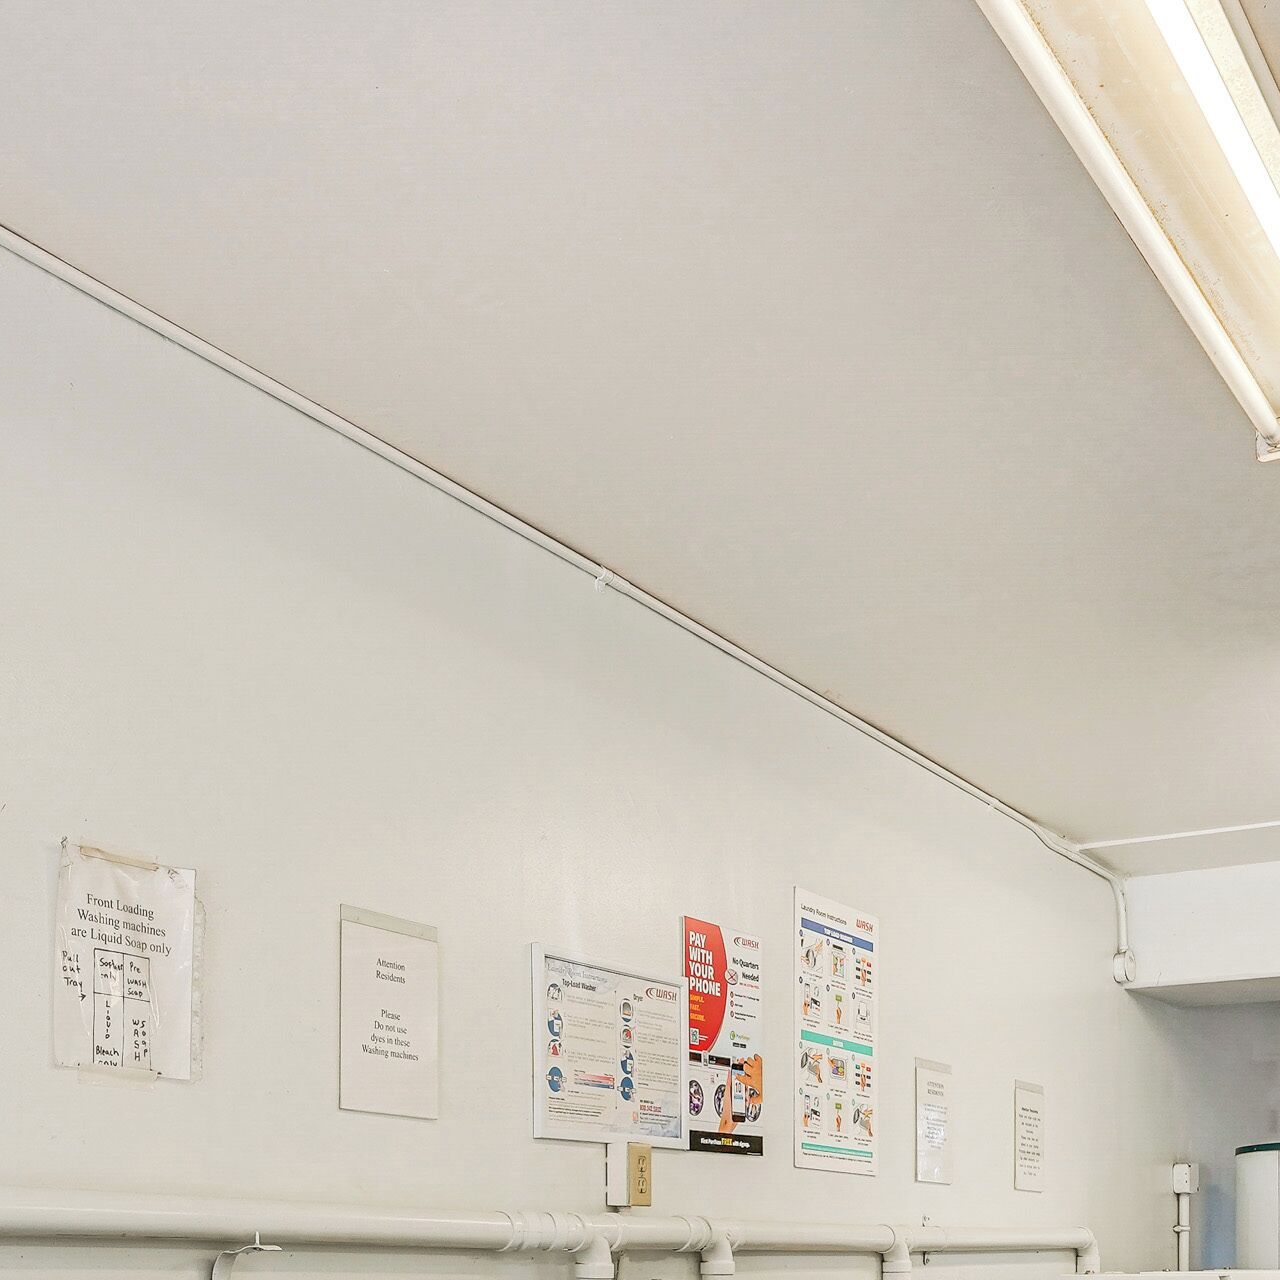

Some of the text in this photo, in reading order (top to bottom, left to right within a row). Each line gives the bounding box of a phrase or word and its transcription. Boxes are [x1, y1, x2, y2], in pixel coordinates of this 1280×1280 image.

[87, 893, 155, 921] Front Loading
[77, 908, 166, 937] Washing machines
[71, 927, 172, 957] are Liquid Soap only
[689, 931, 707, 949] PAY
[376, 957, 406, 972] Attention
[689, 946, 713, 965] WITH
[376, 970, 407, 985] Residents
[689, 961, 715, 980] YOUR
[63, 977, 83, 993] Tray
[689, 976, 721, 997] PHONE
[381, 1008, 402, 1022] Please
[374, 1020, 408, 1035] Do not use
[370, 1033, 386, 1045] dyes
[394, 1036, 411, 1048] these
[361, 1044, 419, 1062] Washing machines
